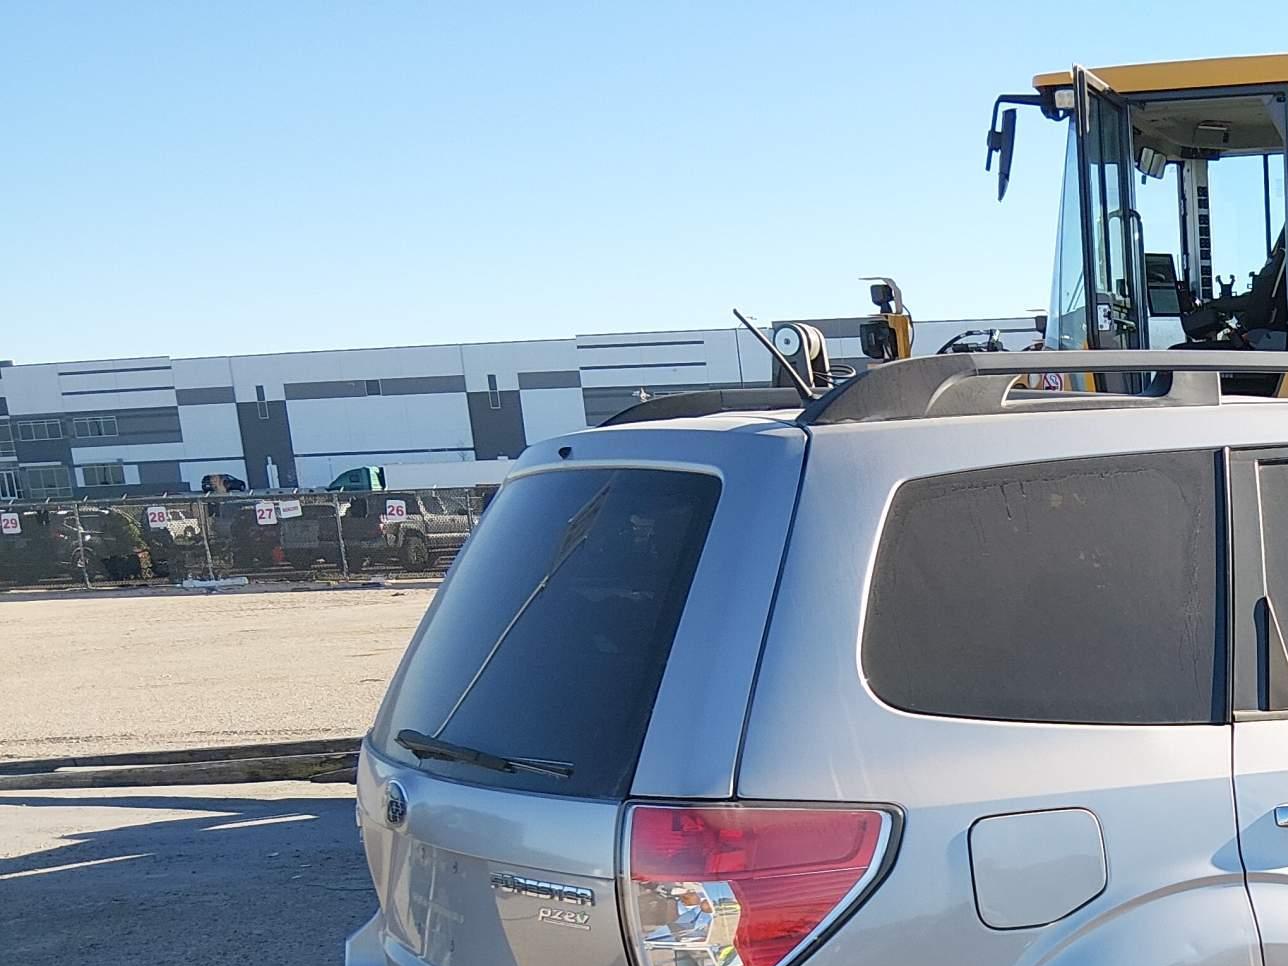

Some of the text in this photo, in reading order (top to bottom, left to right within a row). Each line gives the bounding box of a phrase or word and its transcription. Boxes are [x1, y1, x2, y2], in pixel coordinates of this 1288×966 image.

[149, 511, 166, 523] 28
[257, 508, 273, 520] 27
[387, 505, 405, 517] 26
[2, 518, 18, 529] 29
[489, 872, 595, 906] FORESTER
